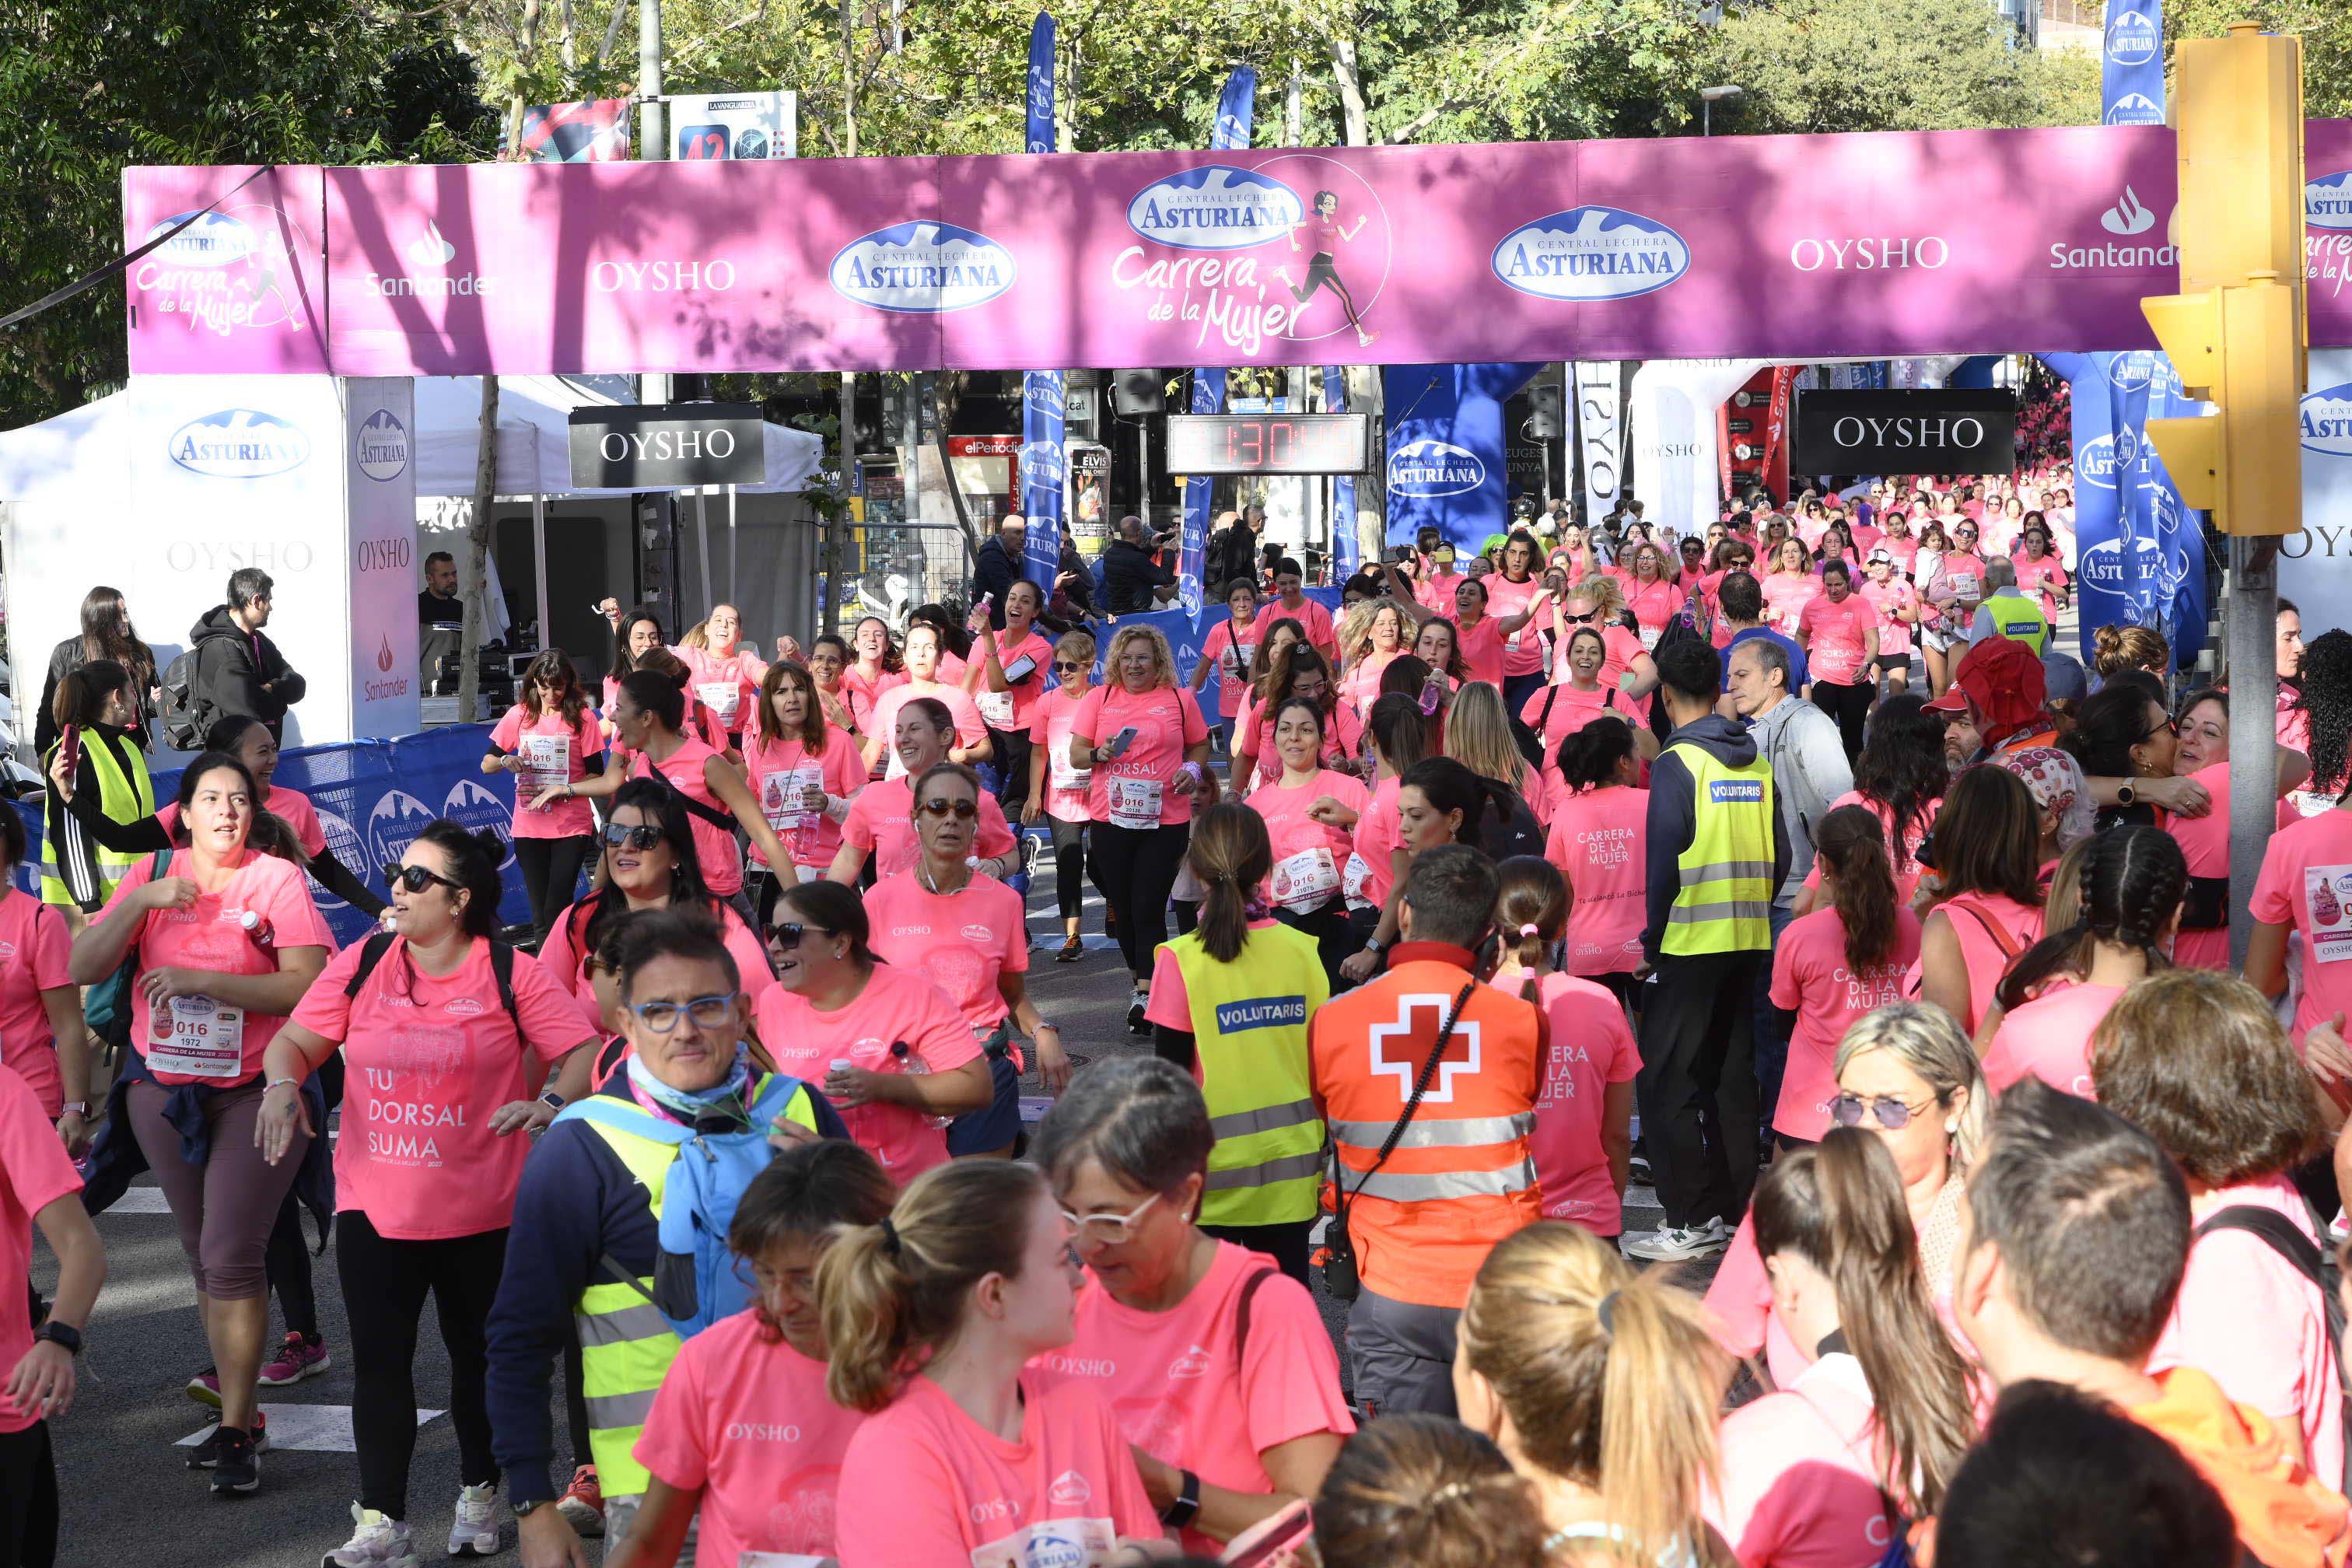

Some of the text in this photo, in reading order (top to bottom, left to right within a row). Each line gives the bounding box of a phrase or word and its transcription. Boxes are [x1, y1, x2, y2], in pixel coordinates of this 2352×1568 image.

[1167, 193, 1289, 205] CENTRAL LECHERA
[1140, 197, 1290, 229] ASTURIANA
[1538, 236, 1668, 249] CENTRAL LECHERA
[873, 250, 996, 261] CENTRAL LECHERA
[1507, 243, 1675, 278] ASTURIANA
[1790, 236, 1949, 271] OYSHO
[2049, 242, 2180, 268] Santand
[136, 262, 229, 291] Carrera
[592, 259, 736, 292] OYSHO
[845, 255, 1002, 289] ASTURIANA
[1111, 246, 1258, 289] Carrera
[366, 272, 499, 296] Santander
[159, 289, 261, 336] de la Mujer
[1147, 288, 1312, 357] de la Mujer
[1833, 416, 1984, 449] OYSHO
[360, 436, 405, 464] ASTURIANA
[600, 428, 736, 462] OYSHO
[1643, 443, 1702, 457] OYSHO
[1082, 456, 1107, 467] ELVIS
[1391, 464, 1479, 485] ASTURIANA
[2277, 526, 2352, 558] OY
[166, 541, 313, 573] OYSHO
[358, 537, 410, 572] OYSHO
[1821, 659, 1847, 667] SUMA
[365, 677, 408, 703] Santander
[1104, 761, 1158, 775] DORSAL
[1125, 798, 1144, 807] 016
[1711, 786, 1760, 799] VOLUNTARIS
[1577, 828, 1635, 843] CARRERA
[1589, 851, 1630, 865] MUJER
[1590, 841, 1626, 854] DE LA
[1293, 873, 1314, 887] 016
[891, 924, 931, 936] OYSHO
[1575, 947, 1602, 956] OYSHO
[1849, 978, 1896, 996] DE LA
[1846, 992, 1899, 1010] MUJER
[1219, 1001, 1305, 1027] VOLUNTARIS
[176, 1020, 208, 1035] 016
[180, 1038, 201, 1047] 1972
[782, 1047, 820, 1059] OYSHO
[1547, 1045, 1589, 1063] ERA
[202, 1062, 233, 1071] Santander
[1548, 1063, 1572, 1081] LA
[365, 1067, 394, 1090] TU
[1540, 1082, 1575, 1099] JER
[368, 1098, 467, 1127] DORSAL
[368, 1130, 440, 1158] SUMA
[1052, 1356, 1115, 1378] OYSHO
[726, 1422, 800, 1444] OYSHO
